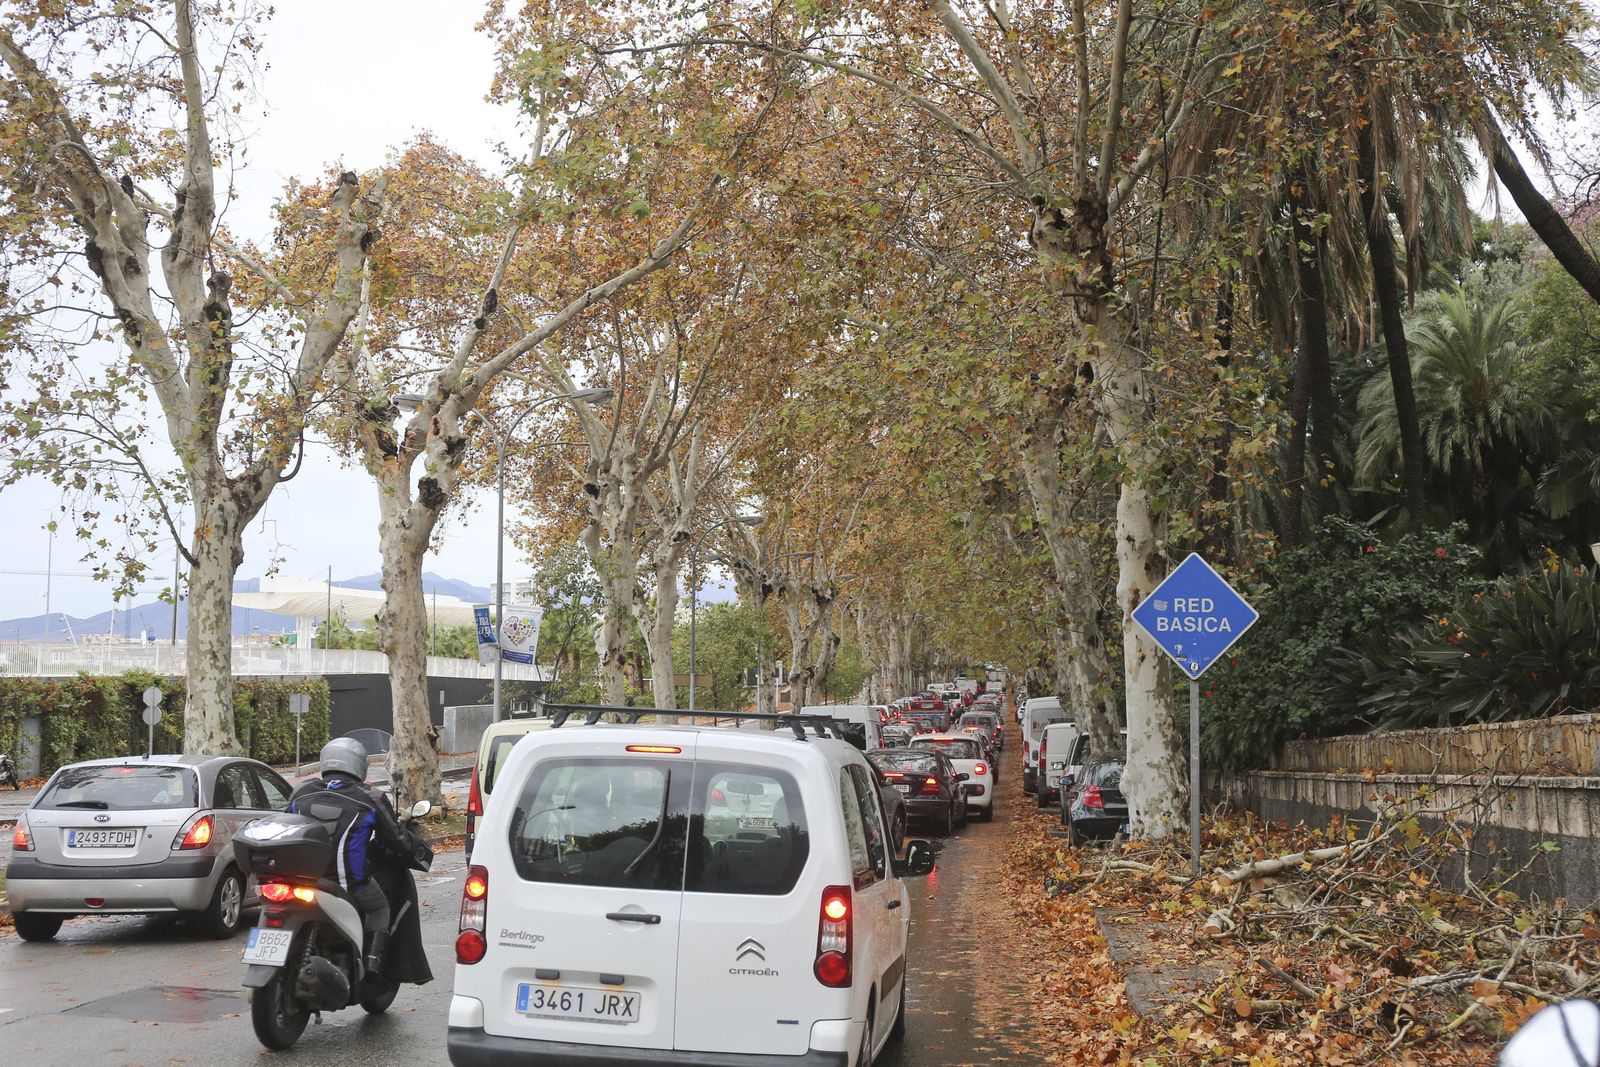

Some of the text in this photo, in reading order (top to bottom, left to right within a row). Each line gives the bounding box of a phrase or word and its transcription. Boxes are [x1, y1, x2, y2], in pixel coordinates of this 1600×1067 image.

[1174, 598, 1215, 613] RED
[1157, 617, 1231, 633] BASICA
[77, 831, 132, 843] 2493 FDH
[260, 933, 289, 946] 8662
[500, 928, 545, 943] Berlingo
[256, 946, 278, 958] JFP
[533, 989, 634, 1017] 3461 JRX
